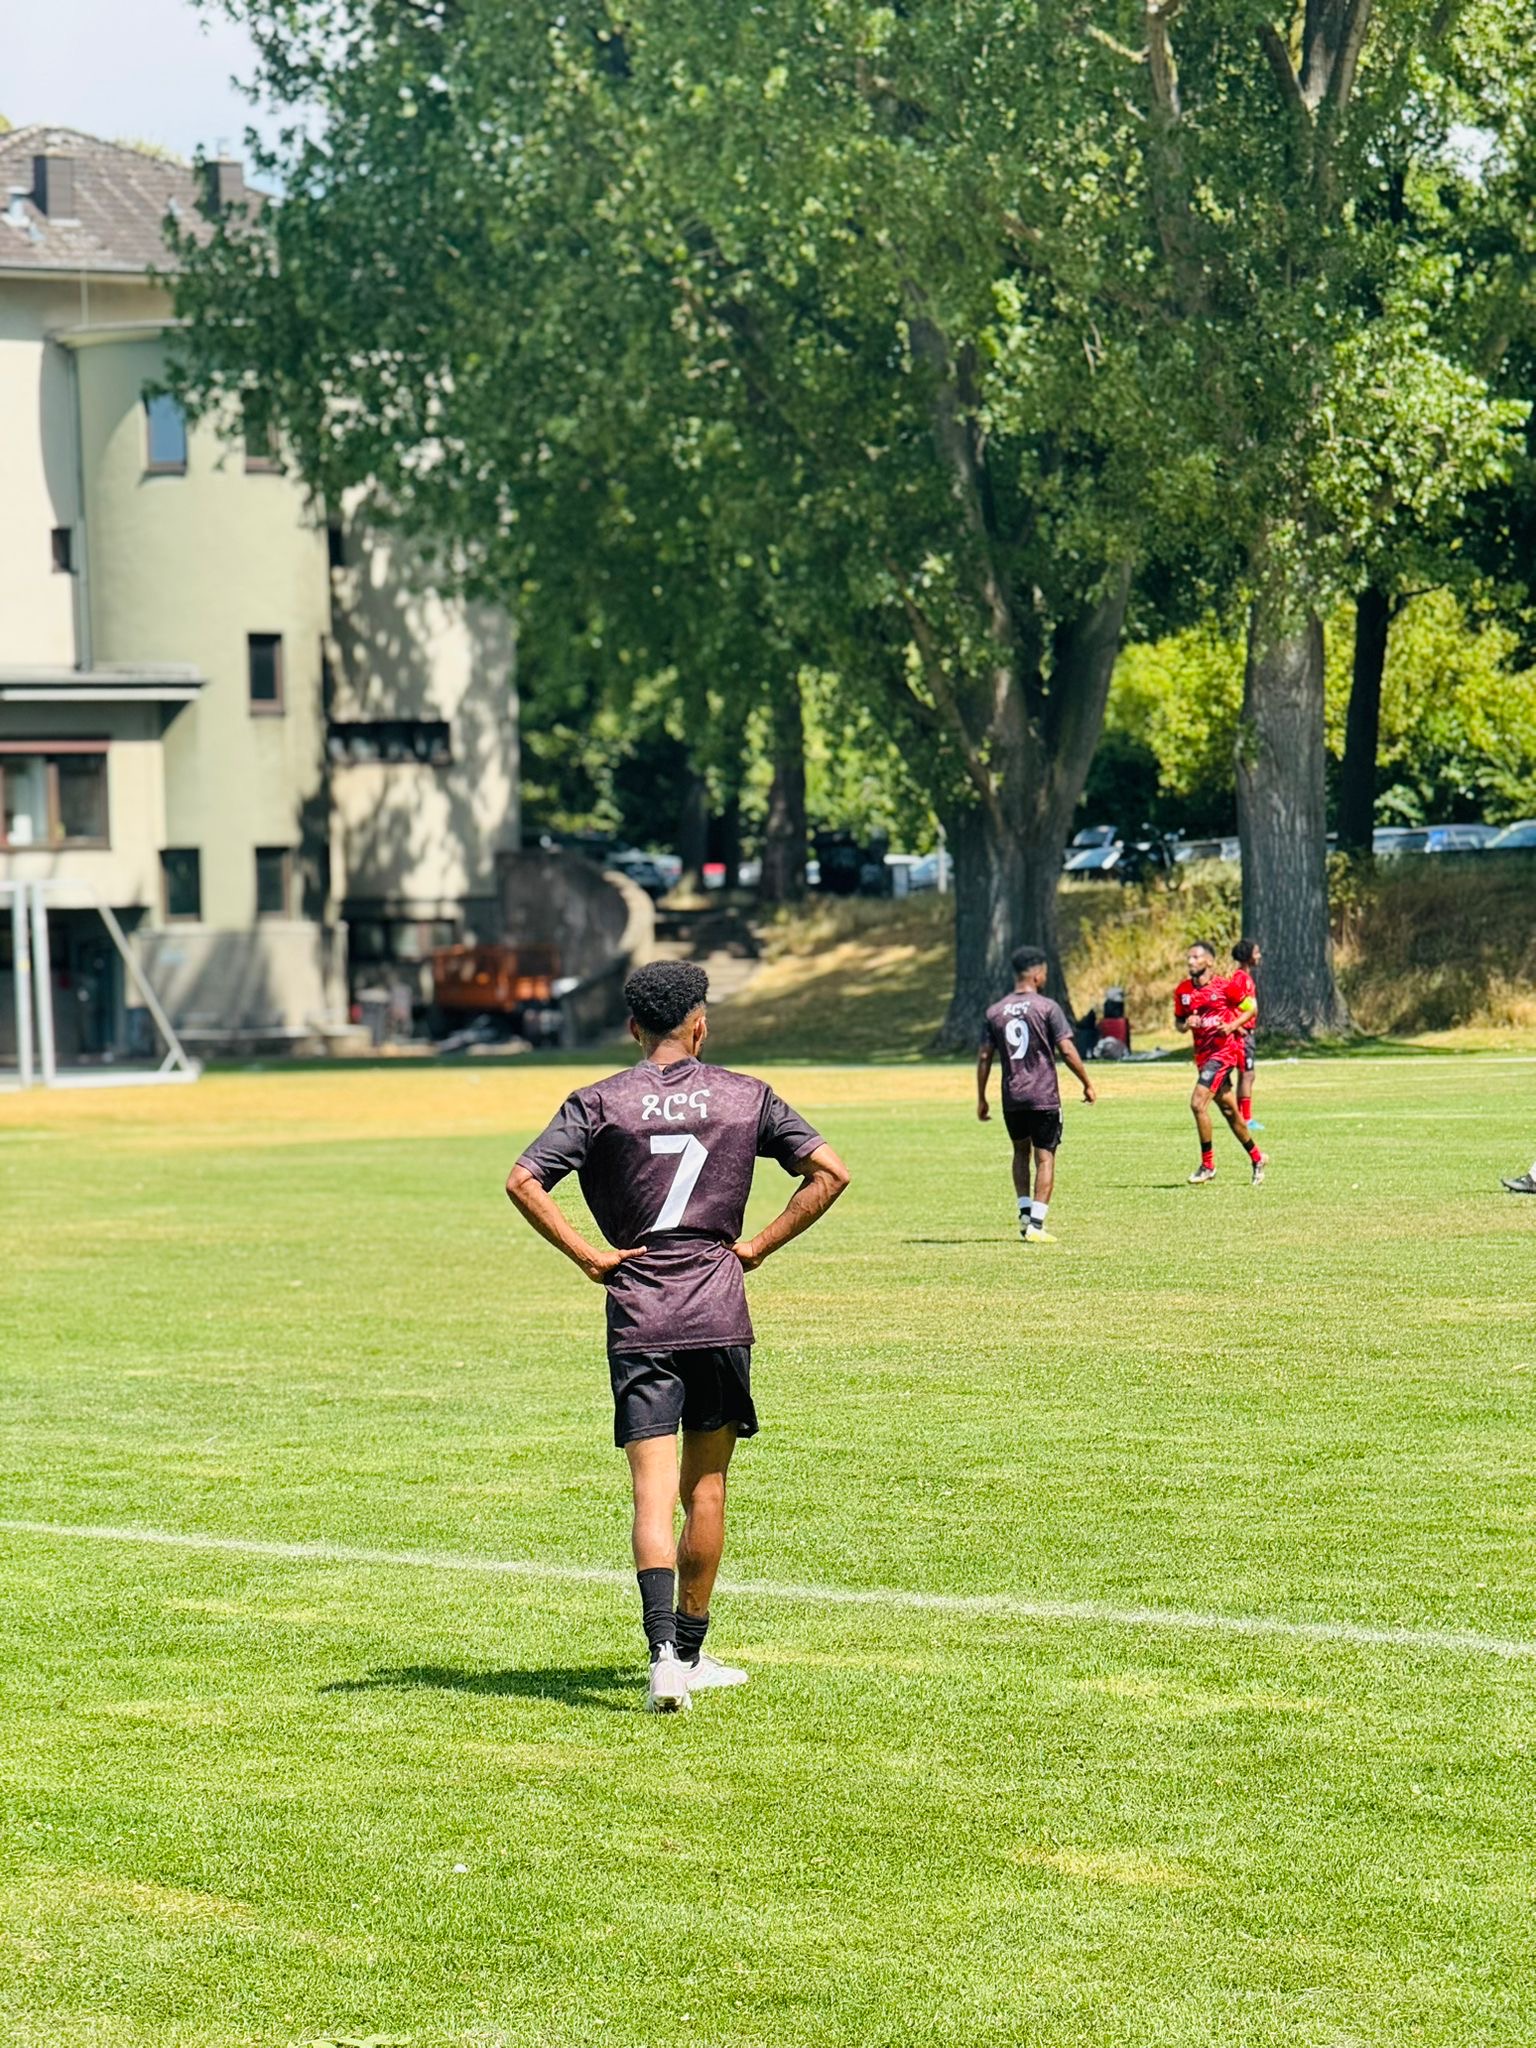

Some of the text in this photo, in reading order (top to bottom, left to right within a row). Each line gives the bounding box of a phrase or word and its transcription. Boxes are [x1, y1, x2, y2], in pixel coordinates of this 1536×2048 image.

[1005, 1018, 1029, 1060] 9
[641, 1089, 711, 1121] ጾሮና
[650, 1134, 709, 1232] 7
